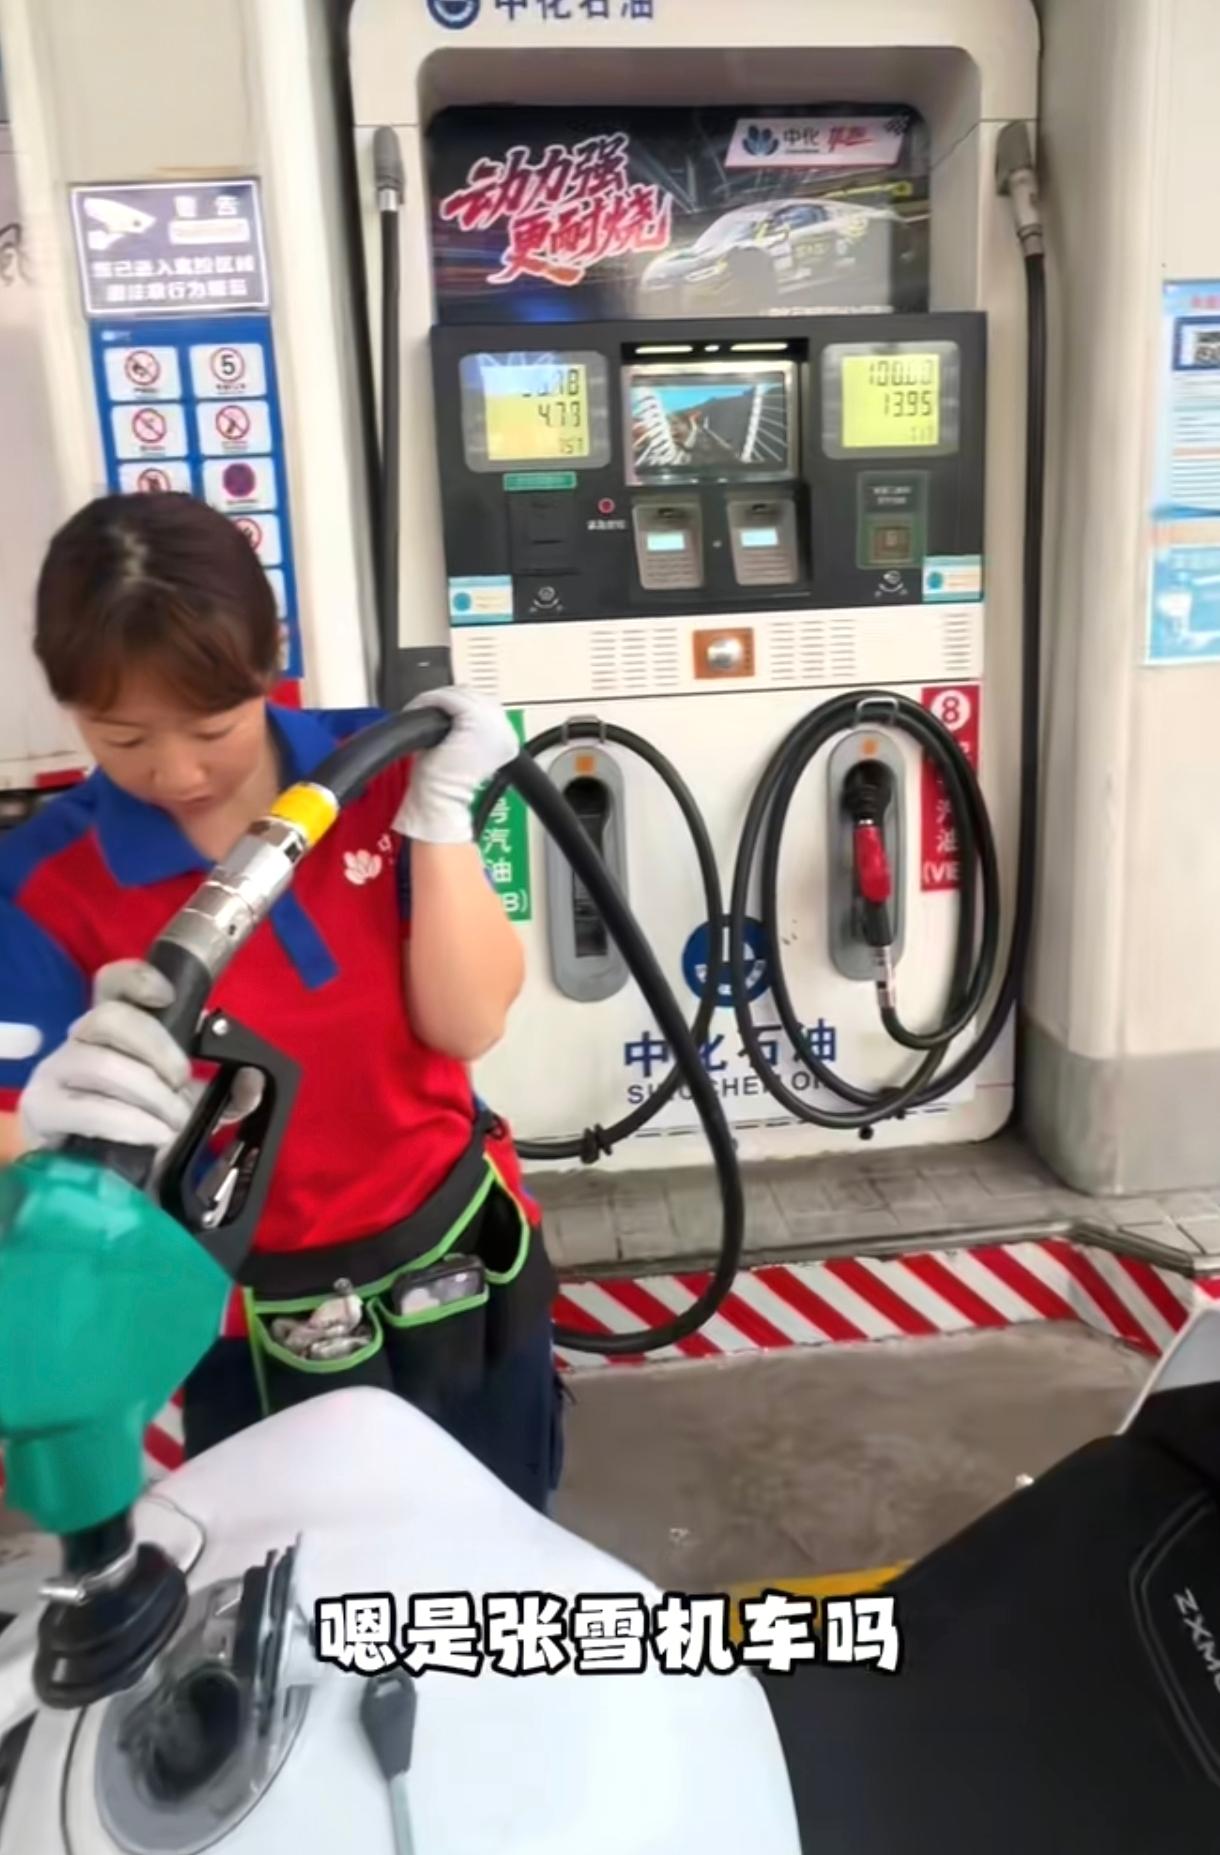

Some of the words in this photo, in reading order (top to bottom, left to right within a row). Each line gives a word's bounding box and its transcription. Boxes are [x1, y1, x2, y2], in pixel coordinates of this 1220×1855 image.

[783, 127, 820, 147] 中化
[440, 131, 629, 231] 动力强
[487, 183, 673, 286] 更耐烧
[221, 354, 235, 376] 5
[942, 696, 960, 723] 8
